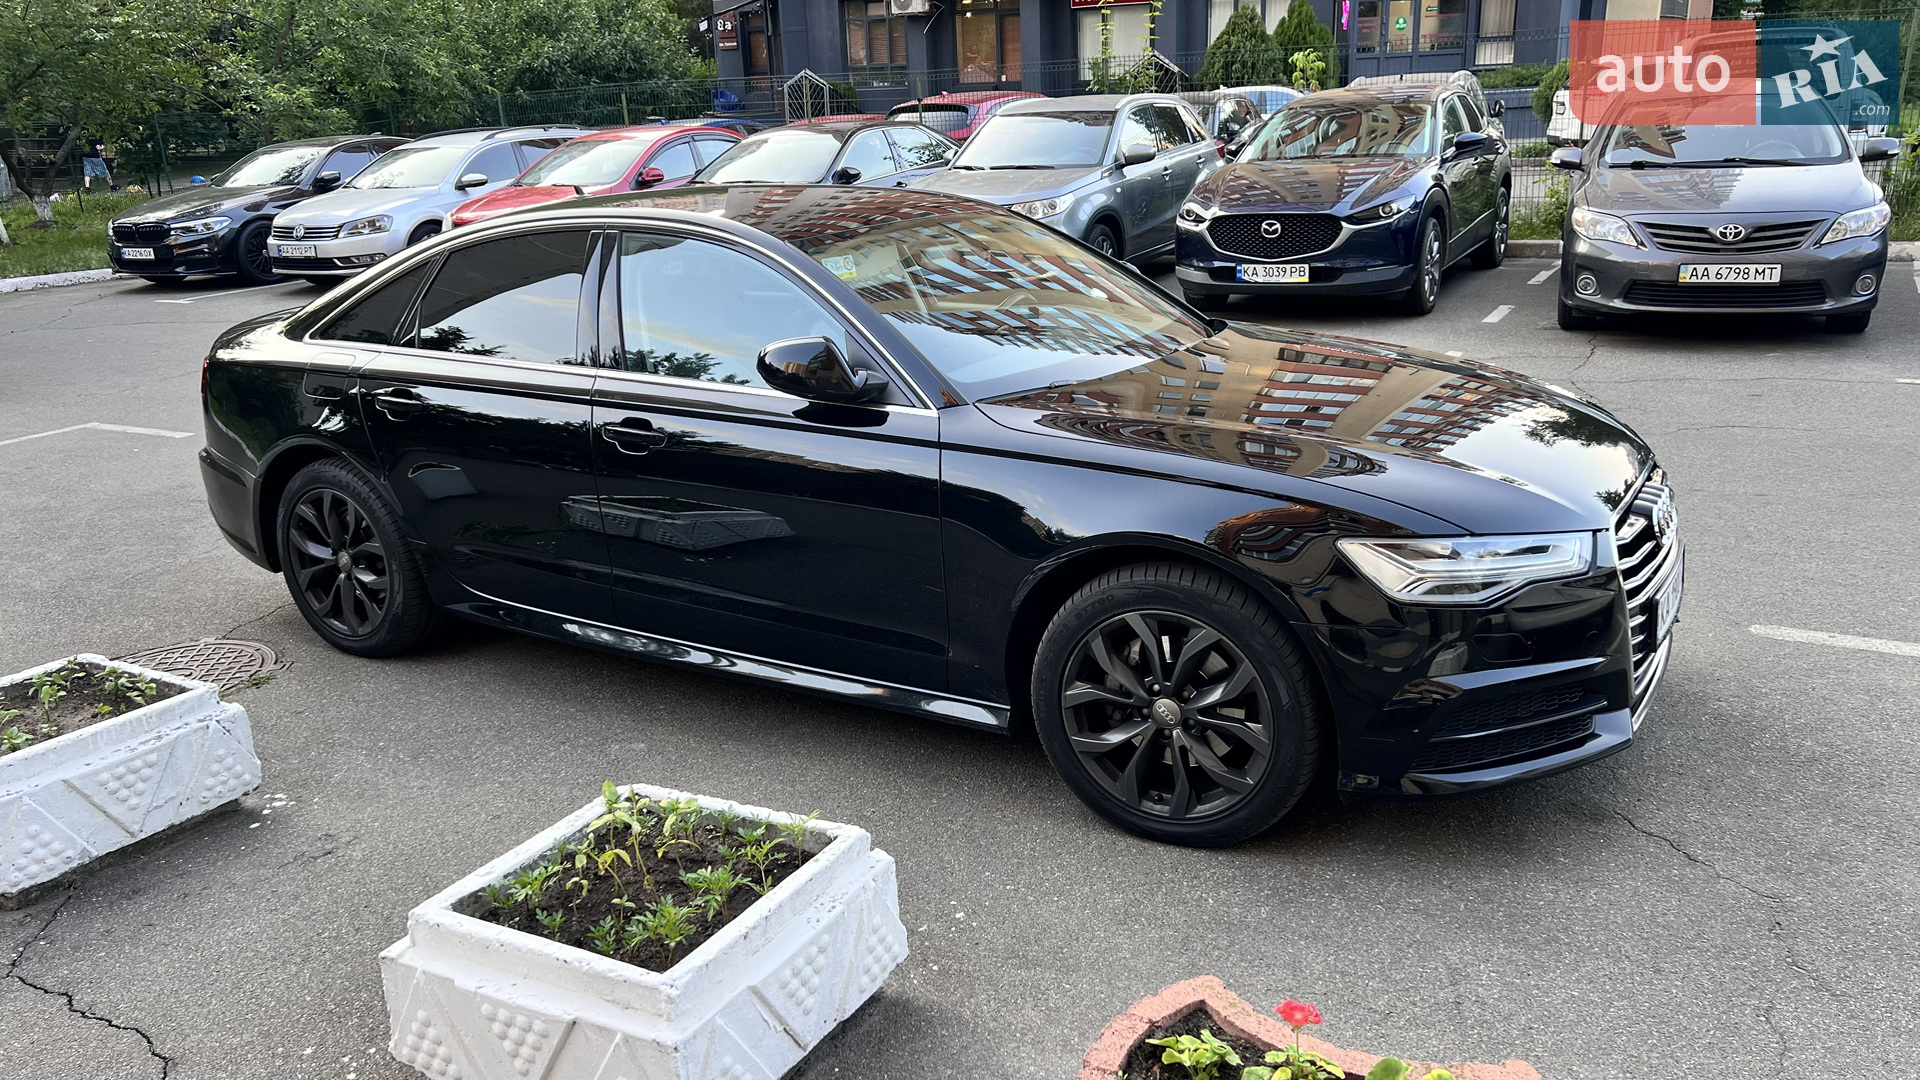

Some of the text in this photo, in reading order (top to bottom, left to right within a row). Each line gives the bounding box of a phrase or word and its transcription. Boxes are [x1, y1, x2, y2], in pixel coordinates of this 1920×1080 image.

[1243, 266, 1307, 277] KA 3039 PB
[1689, 267, 1777, 280] AA 6798 MT
